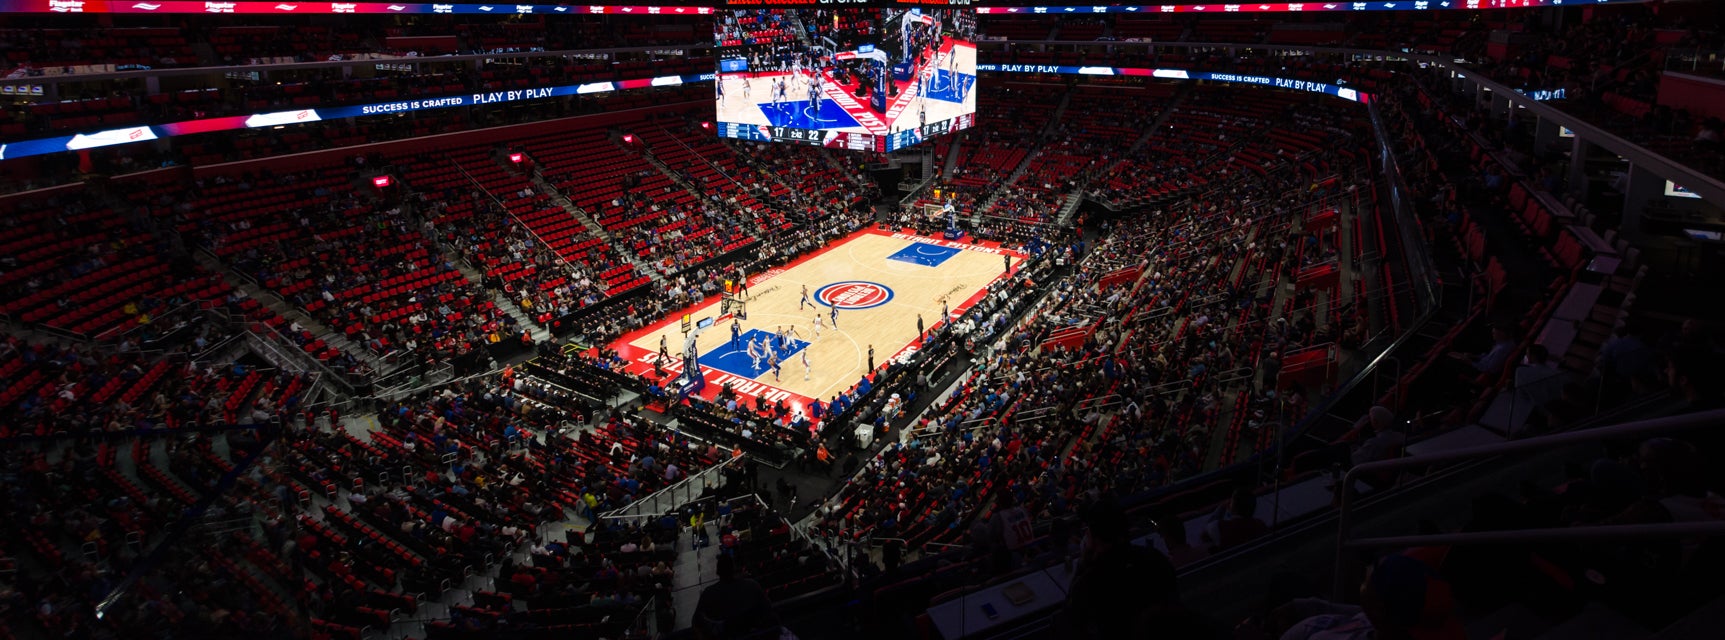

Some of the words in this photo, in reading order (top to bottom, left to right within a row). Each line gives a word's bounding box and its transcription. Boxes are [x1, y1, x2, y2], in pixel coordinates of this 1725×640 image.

[1002, 64, 1022, 72] PLAY
[1037, 65, 1059, 73] PLAY
[1211, 73, 1235, 81] SUCCESS
[1243, 76, 1270, 84] CRAFTED
[1275, 77, 1293, 88] PLAY
[1294, 80, 1306, 90] BY
[1306, 82, 1327, 93] PLAY
[362, 103, 408, 114] SUCCESS
[410, 101, 420, 109] IS
[422, 97, 462, 108] CRAFTED
[473, 92, 503, 104] PLAY
[507, 90, 523, 101] BY
[526, 87, 553, 99] PLAY
[774, 127, 784, 137] 17
[808, 130, 819, 141] 22
[890, 233, 943, 245] DETROIT
[945, 241, 1003, 254] PISTONS
[710, 374, 792, 403] DETROIT
